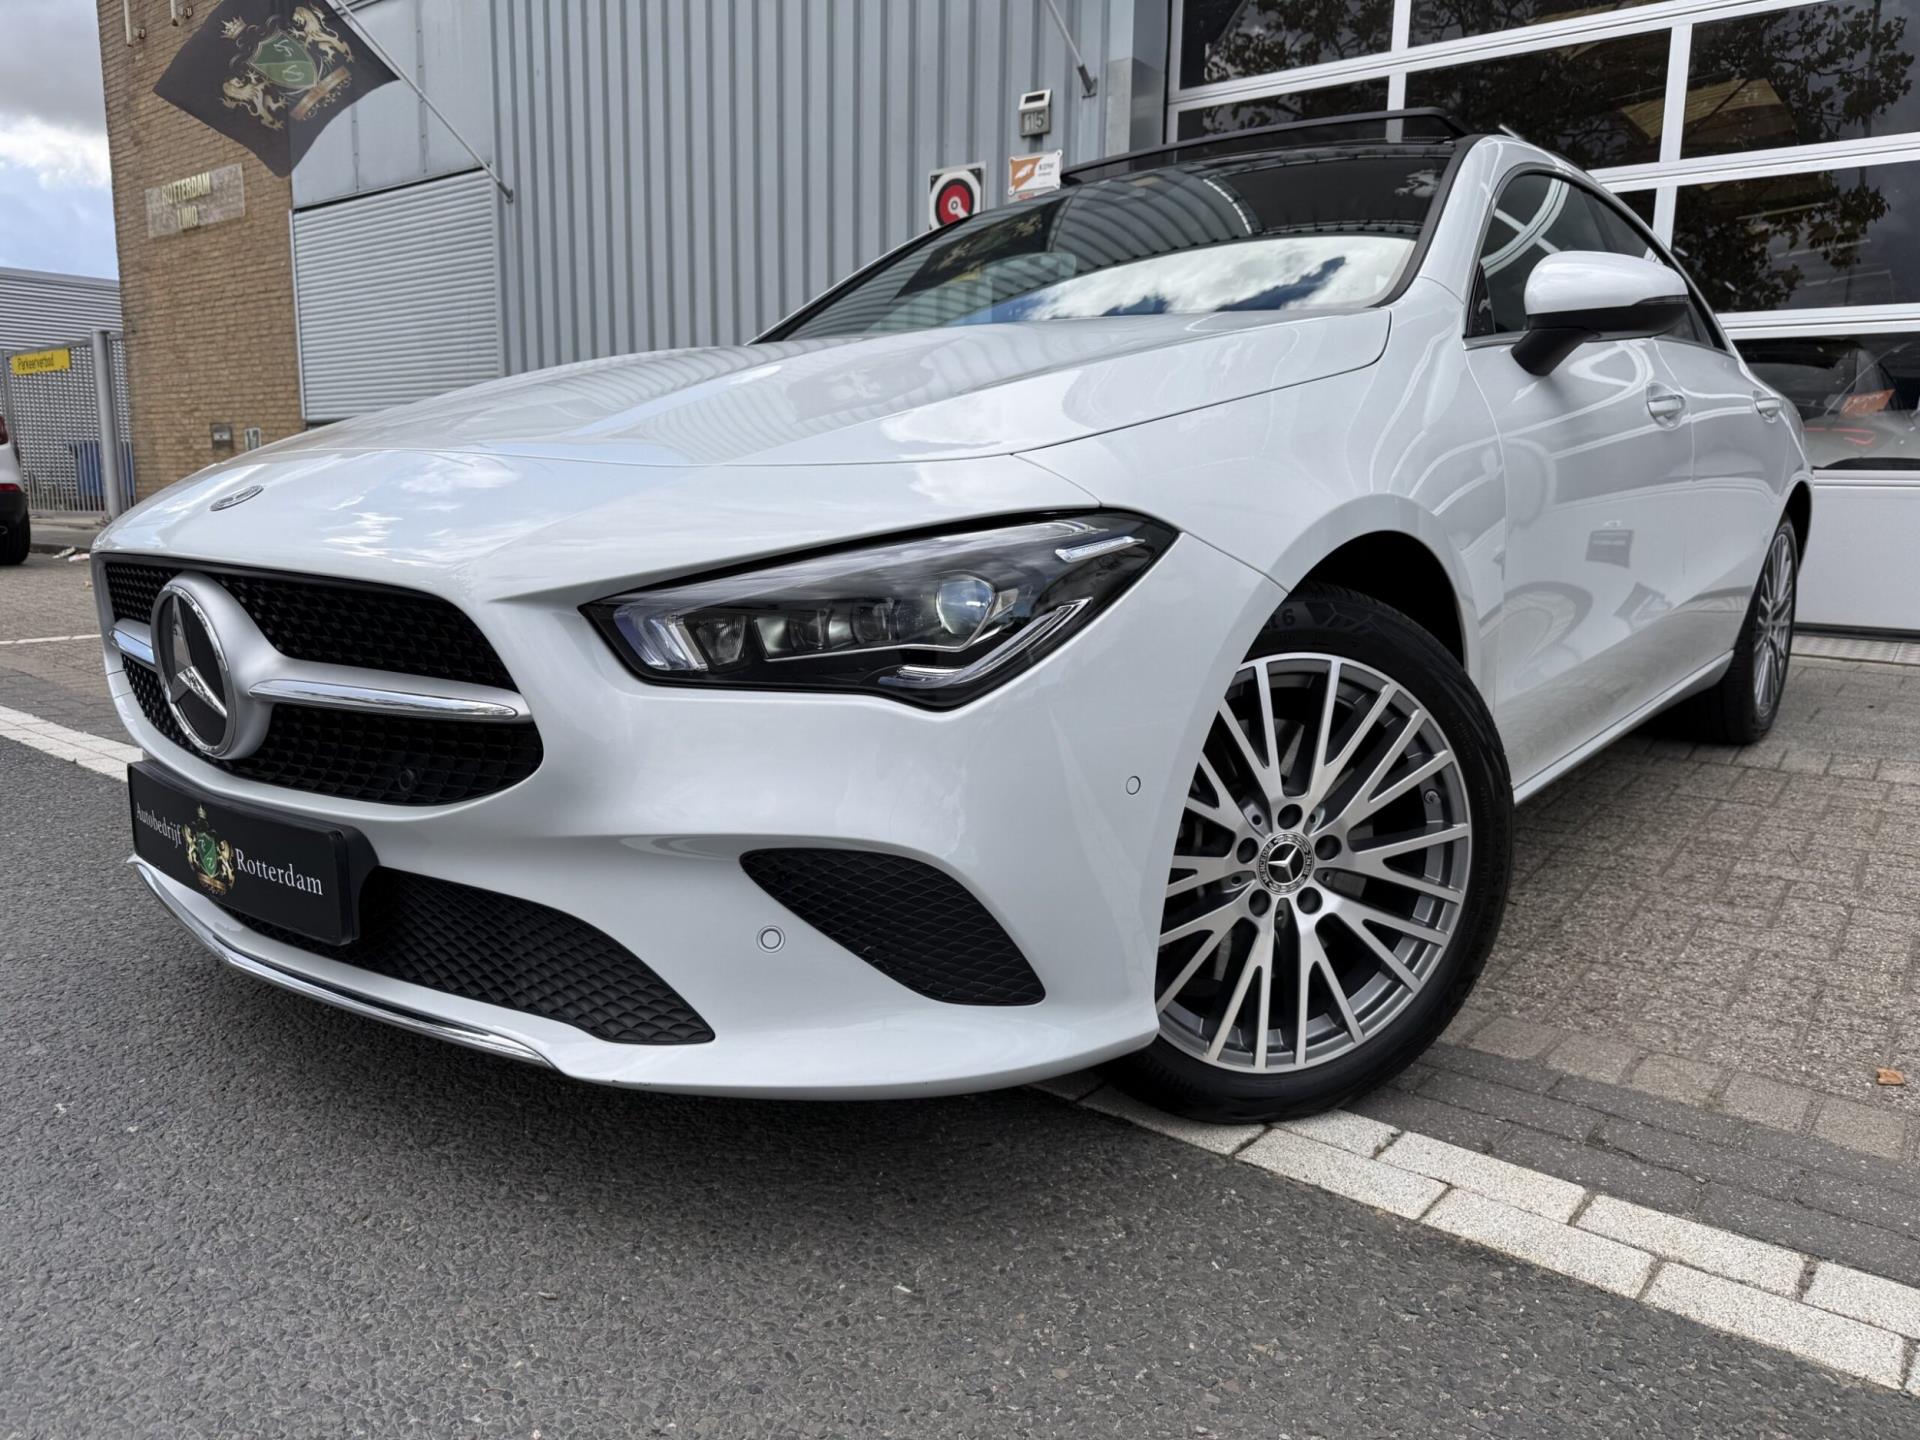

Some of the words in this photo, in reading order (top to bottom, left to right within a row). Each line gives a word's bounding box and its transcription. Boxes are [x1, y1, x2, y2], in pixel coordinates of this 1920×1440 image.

[1026, 114, 1044, 130] 15
[161, 172, 211, 205] ROTTERDAM
[177, 205, 198, 229] LIMO
[136, 803, 182, 848] Autobedrijf
[235, 848, 324, 896] Rotterdam
